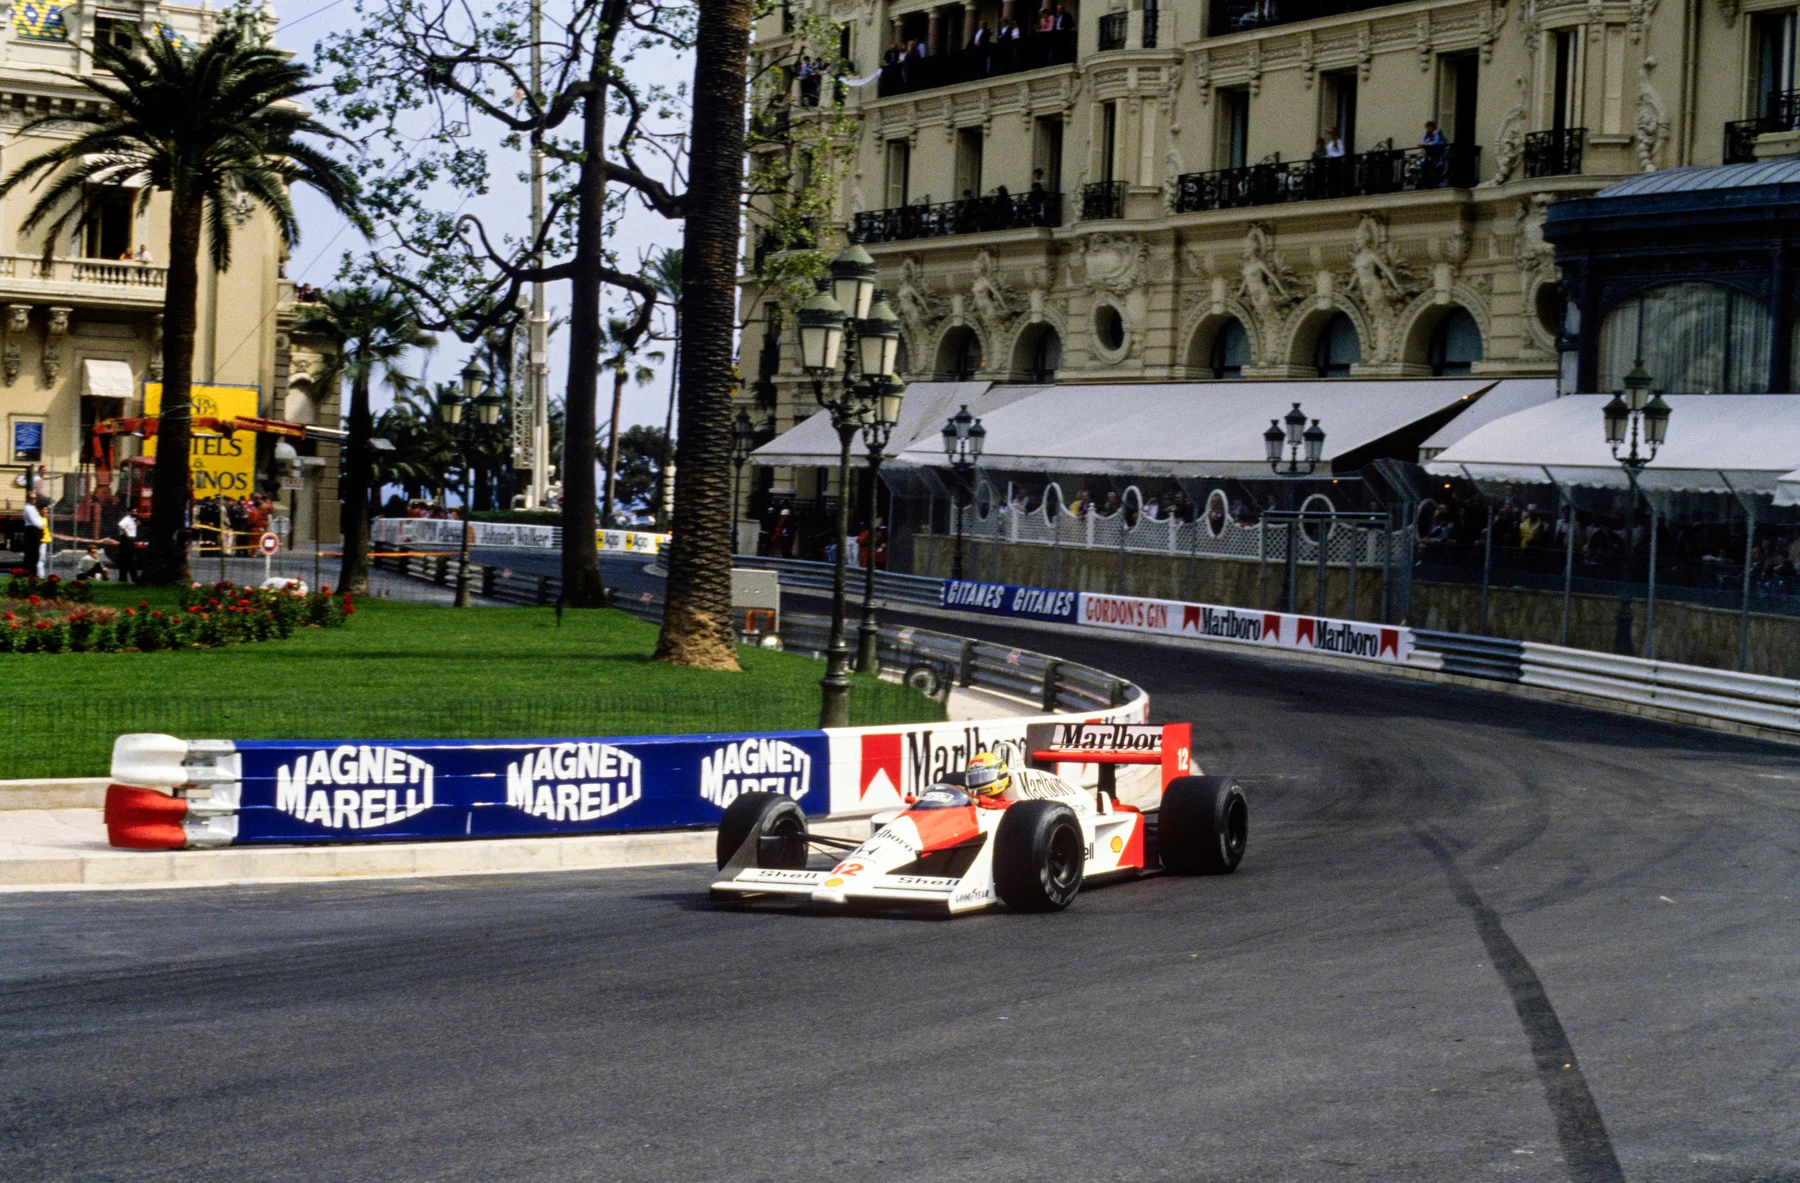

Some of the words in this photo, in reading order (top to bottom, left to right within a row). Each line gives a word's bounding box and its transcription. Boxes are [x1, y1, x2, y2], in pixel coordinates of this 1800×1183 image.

[191, 436, 242, 457] TELS
[194, 458, 204, 468] &
[194, 471, 247, 491] INOS
[947, 581, 1005, 609] GITANES
[1012, 587, 1075, 616] GITANES
[1086, 596, 1144, 627] GORDON'S
[1146, 603, 1168, 629] GIN
[1201, 607, 1262, 641] Marlboro
[1314, 619, 1378, 657] Marlboro
[1060, 723, 1163, 751] Marlbor
[277, 745, 434, 790] MAGNETI
[507, 742, 641, 785] MAGNETI
[701, 738, 811, 778] MAGNETI
[1177, 747, 1189, 771] 12
[277, 782, 434, 829] MARELLI
[507, 777, 641, 821] MARELLI
[877, 829, 914, 852] lboro
[1083, 842, 1094, 860] ell
[758, 869, 818, 880] Shell
[831, 863, 864, 877] 12
[899, 876, 961, 887] Shell
